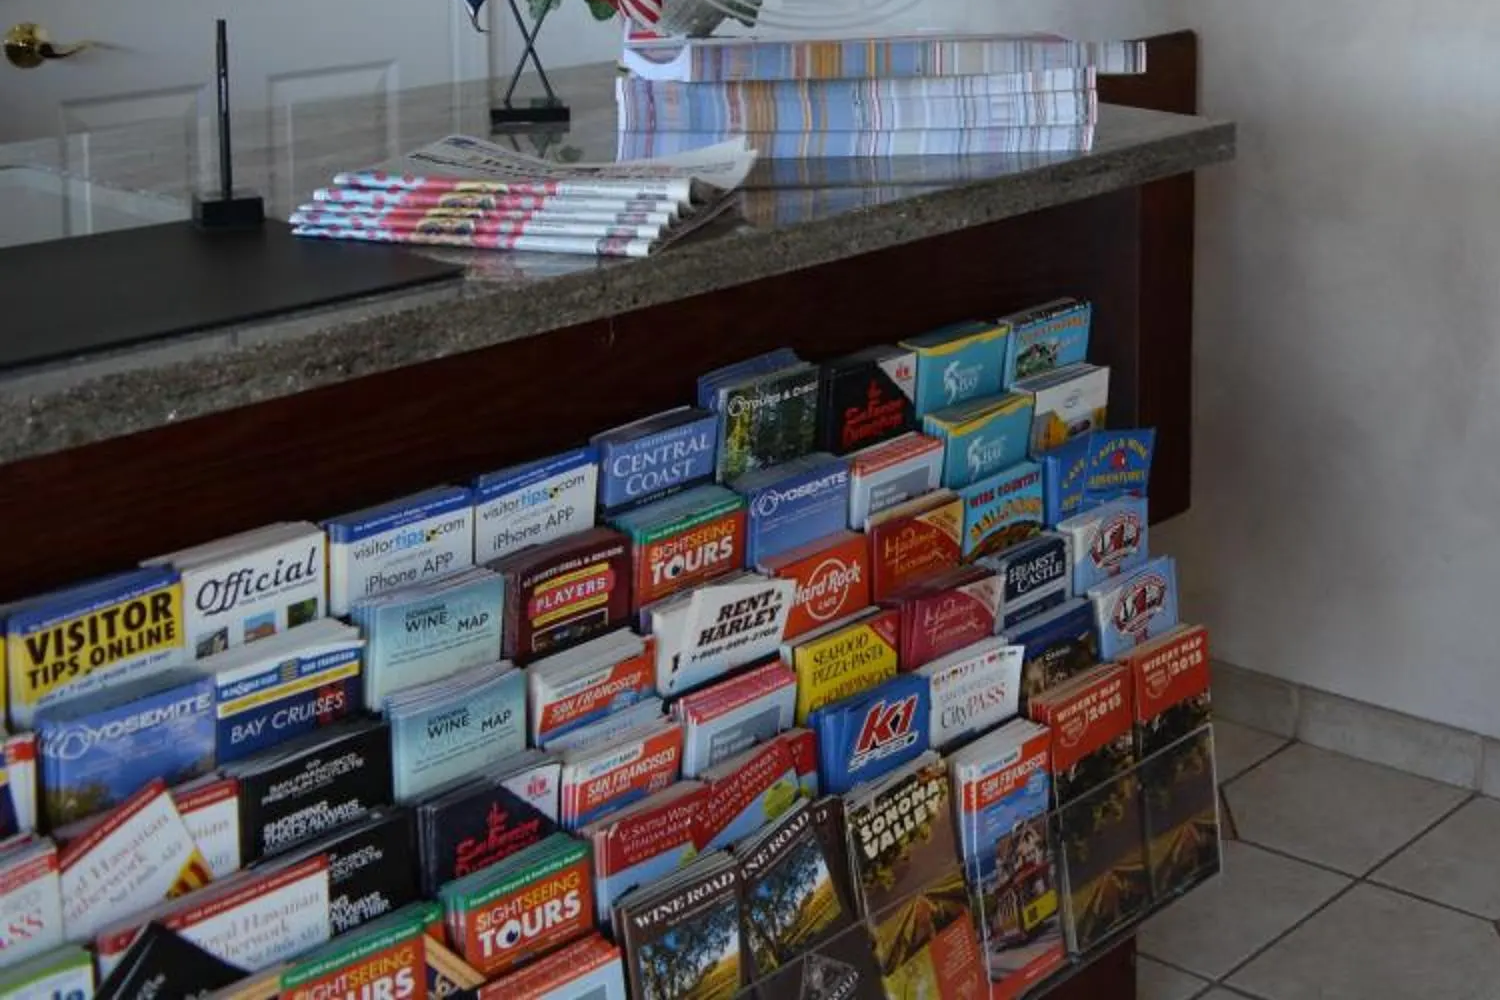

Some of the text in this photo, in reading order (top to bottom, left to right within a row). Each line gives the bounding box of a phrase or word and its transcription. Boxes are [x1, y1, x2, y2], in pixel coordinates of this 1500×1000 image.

[613, 433, 712, 477] CENTRAL
[626, 458, 696, 495] COAST
[493, 505, 575, 551] iPhone APP
[195, 546, 317, 616] Official
[365, 550, 454, 595] iPhone APP
[652, 536, 733, 585] TOURS
[794, 561, 861, 606] Hard Rock
[1017, 560, 1063, 593] CASTLE
[536, 577, 606, 612] PLAYERS
[717, 588, 775, 623] RENT
[25, 592, 173, 665] VISITOR
[406, 611, 449, 632] WINE
[458, 613, 489, 632] MAP
[698, 604, 782, 648] HARLEY
[28, 655, 80, 690] TIPS
[90, 620, 175, 666] ONLINE
[230, 691, 344, 745] BAY CRUISES
[427, 714, 471, 739] WINE
[481, 709, 512, 732] MAP
[861, 780, 939, 842] SONOMA
[864, 795, 938, 860] VALLEY
[740, 811, 809, 879] INE ROAD
[476, 871, 581, 930] SIGHTSEEING
[477, 889, 582, 958] TOURS
[635, 873, 735, 928] WINE ROAD
